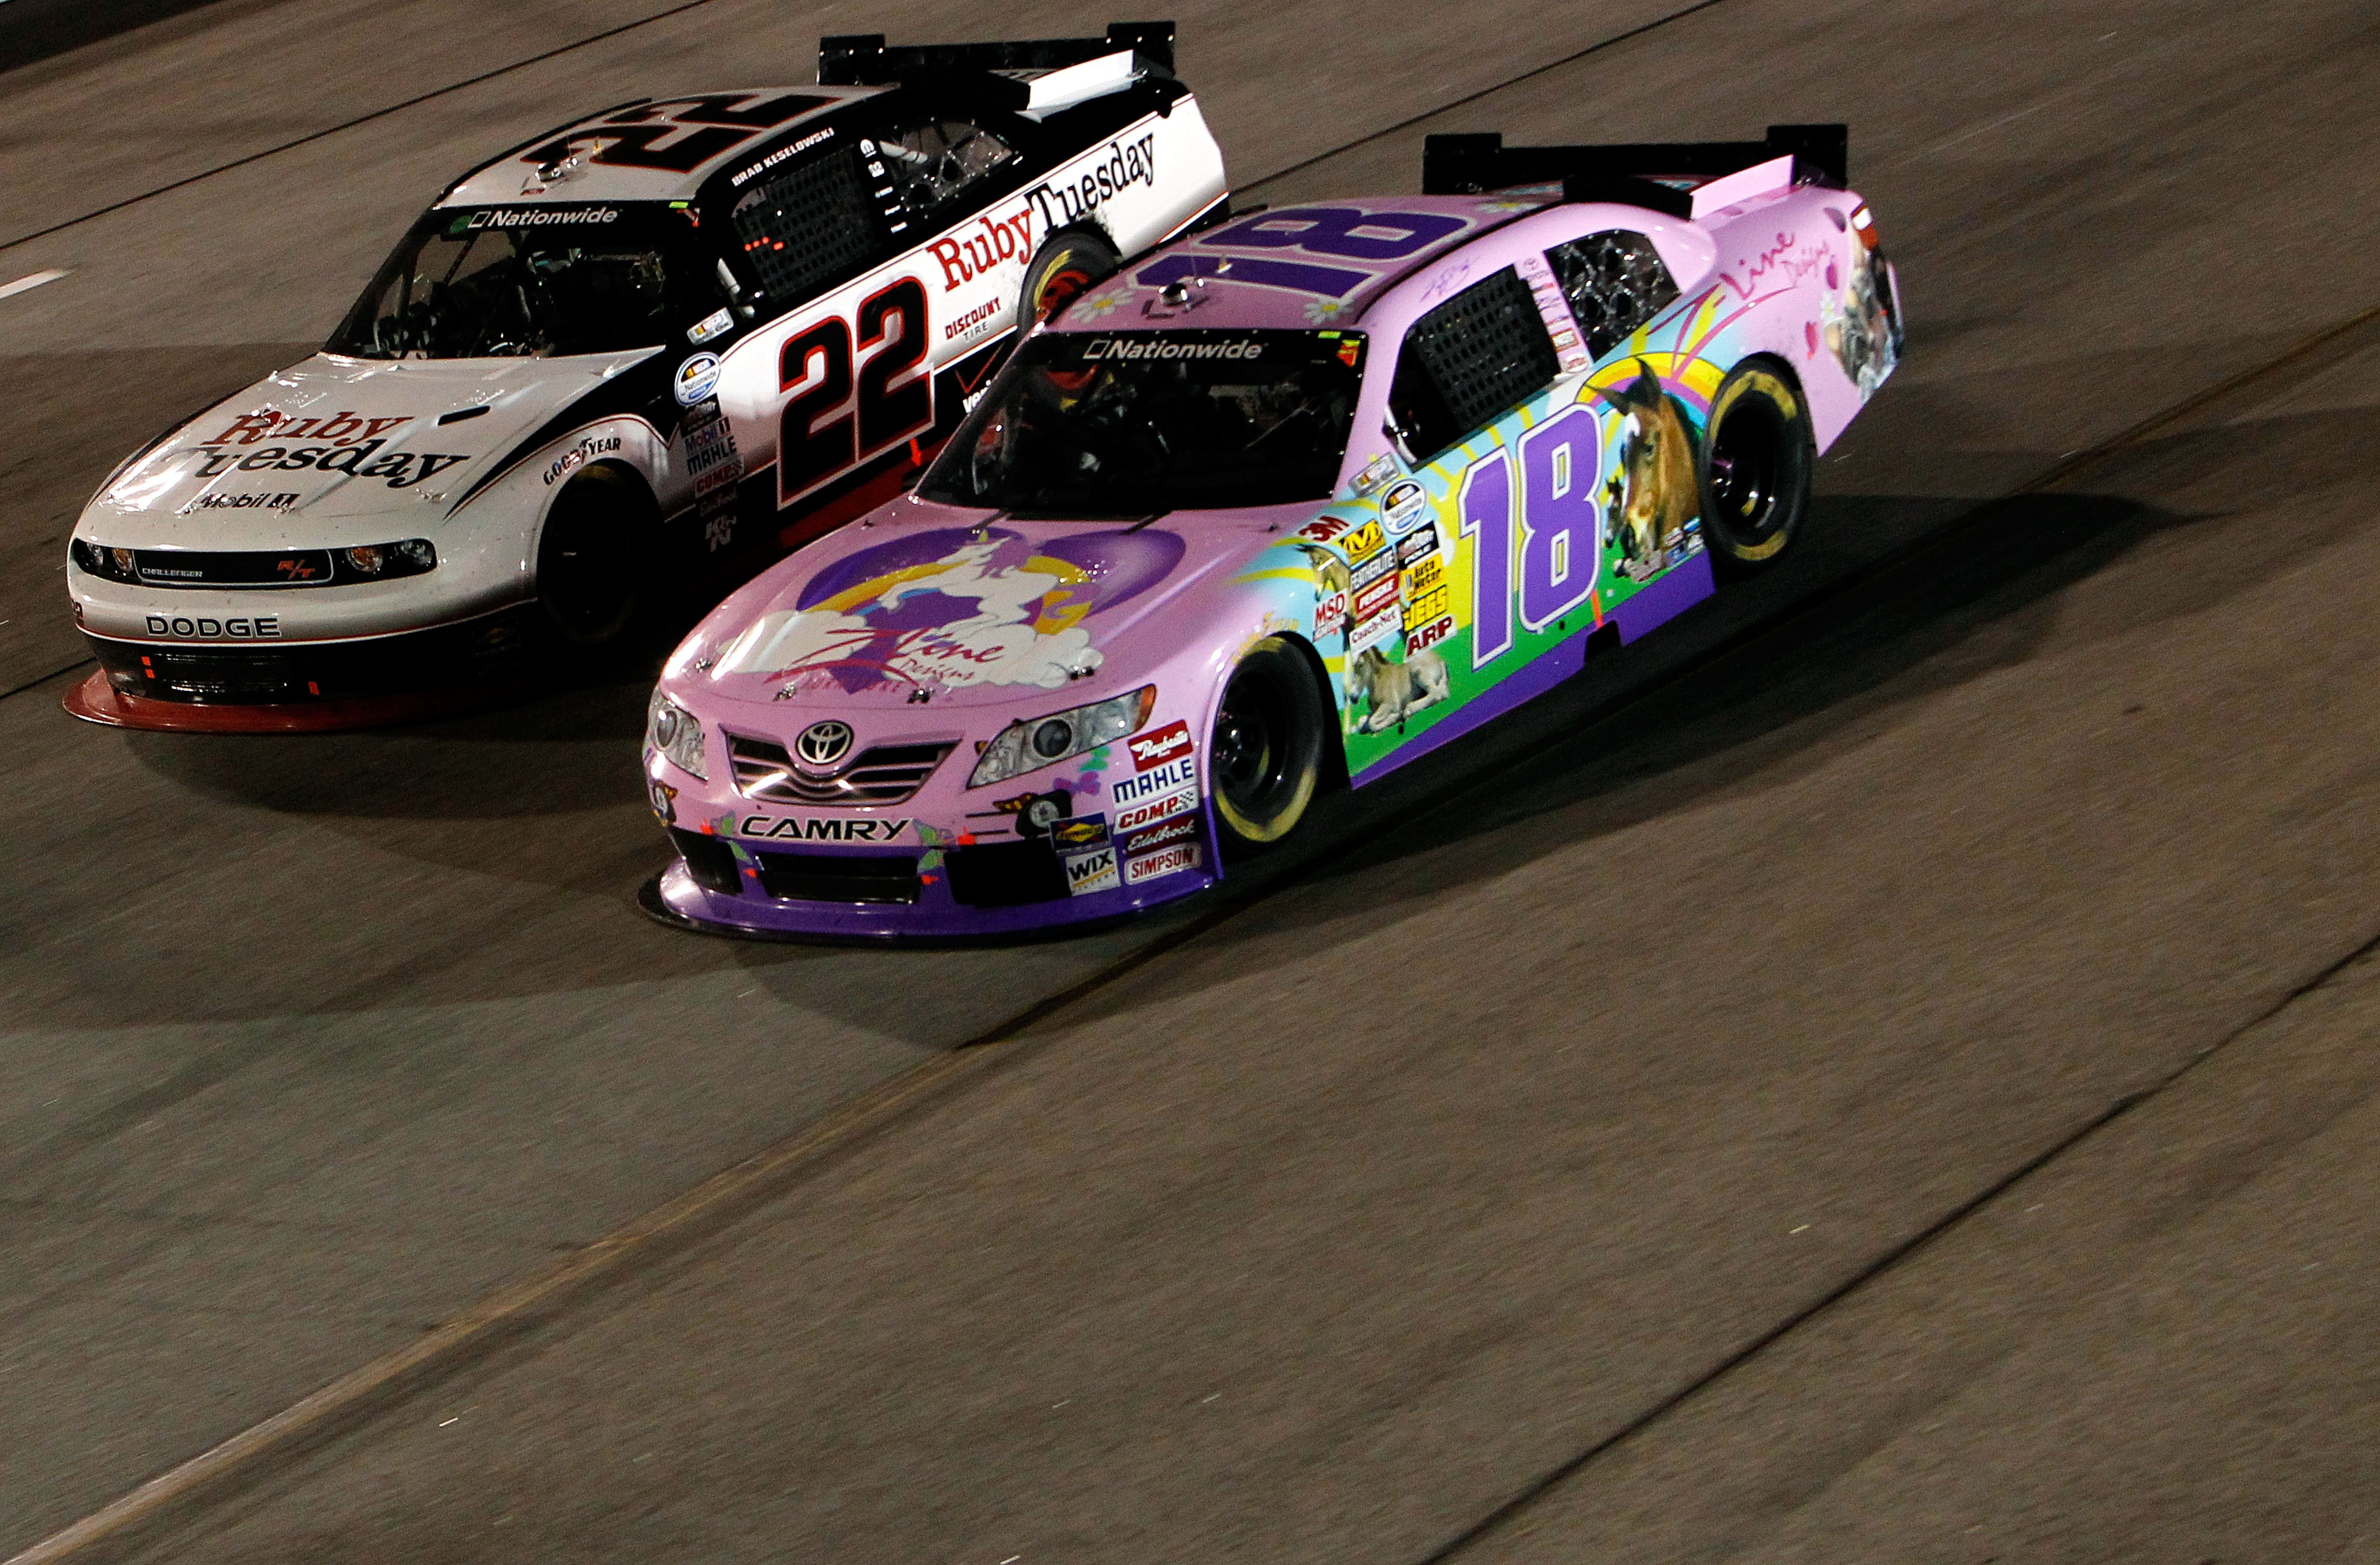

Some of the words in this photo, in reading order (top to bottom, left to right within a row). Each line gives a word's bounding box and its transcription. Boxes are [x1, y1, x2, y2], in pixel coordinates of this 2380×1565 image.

[731, 163, 762, 187] BRAD
[763, 127, 836, 169] KESELOWSKI
[487, 208, 619, 227] Nationwide
[927, 209, 1034, 293] Ruby
[1024, 132, 1154, 229] Tuesday
[1127, 205, 1477, 299] 18
[944, 297, 1002, 340] DISCOUNT
[962, 321, 989, 343] TIRE
[1108, 339, 1264, 360] Nationwide
[777, 275, 936, 512] 22
[199, 409, 415, 446] Ruby
[179, 438, 472, 488] Tuesday
[687, 435, 737, 476] MAHLE
[1298, 516, 1351, 541] 3M
[1457, 402, 1604, 671] 18
[276, 559, 316, 580] R/T
[145, 616, 282, 638] DODGE
[1315, 593, 1345, 628] MSD
[1406, 616, 1453, 657] ARP
[1113, 759, 1194, 803] MAHLE
[739, 814, 913, 841] CAMRY
[1119, 796, 1178, 829] COMP
[1069, 850, 1113, 881] WIX
[1131, 847, 1194, 878] SIMPSON
